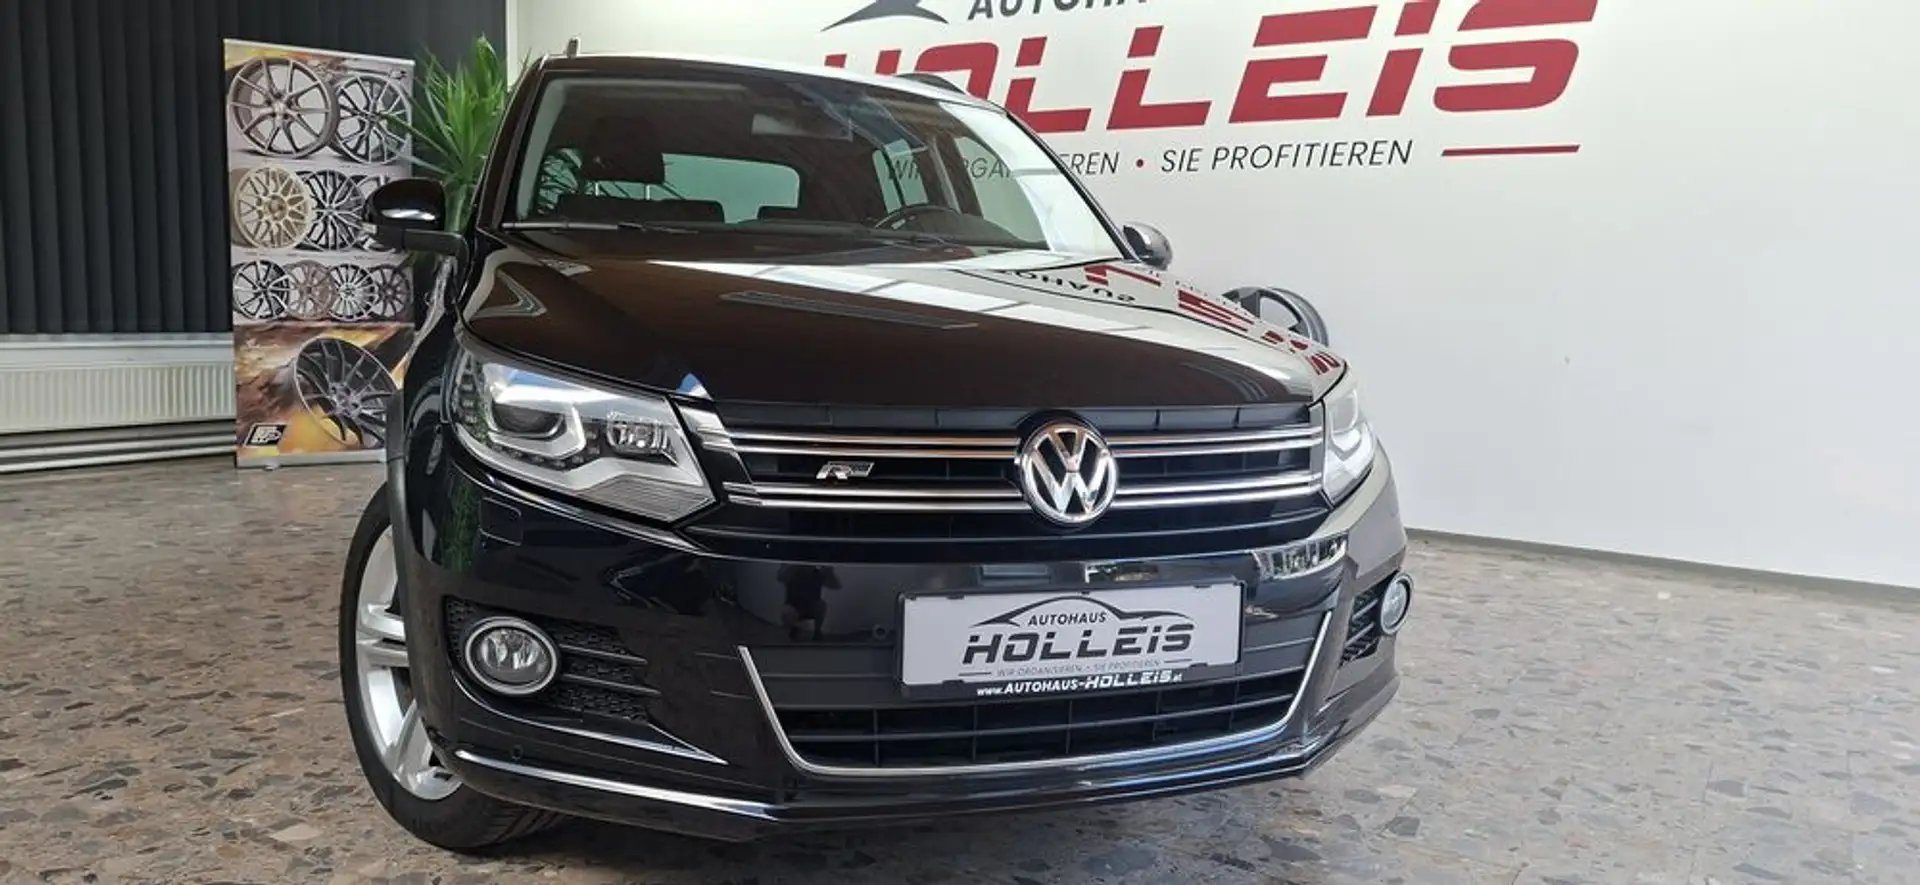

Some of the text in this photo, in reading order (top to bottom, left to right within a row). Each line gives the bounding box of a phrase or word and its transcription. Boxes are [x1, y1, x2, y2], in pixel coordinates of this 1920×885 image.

[824, 0, 1598, 133] OLLEIS
[1161, 140, 1413, 173] SIE PROFITIEREN
[1028, 612, 1107, 626] AUTOHAUS
